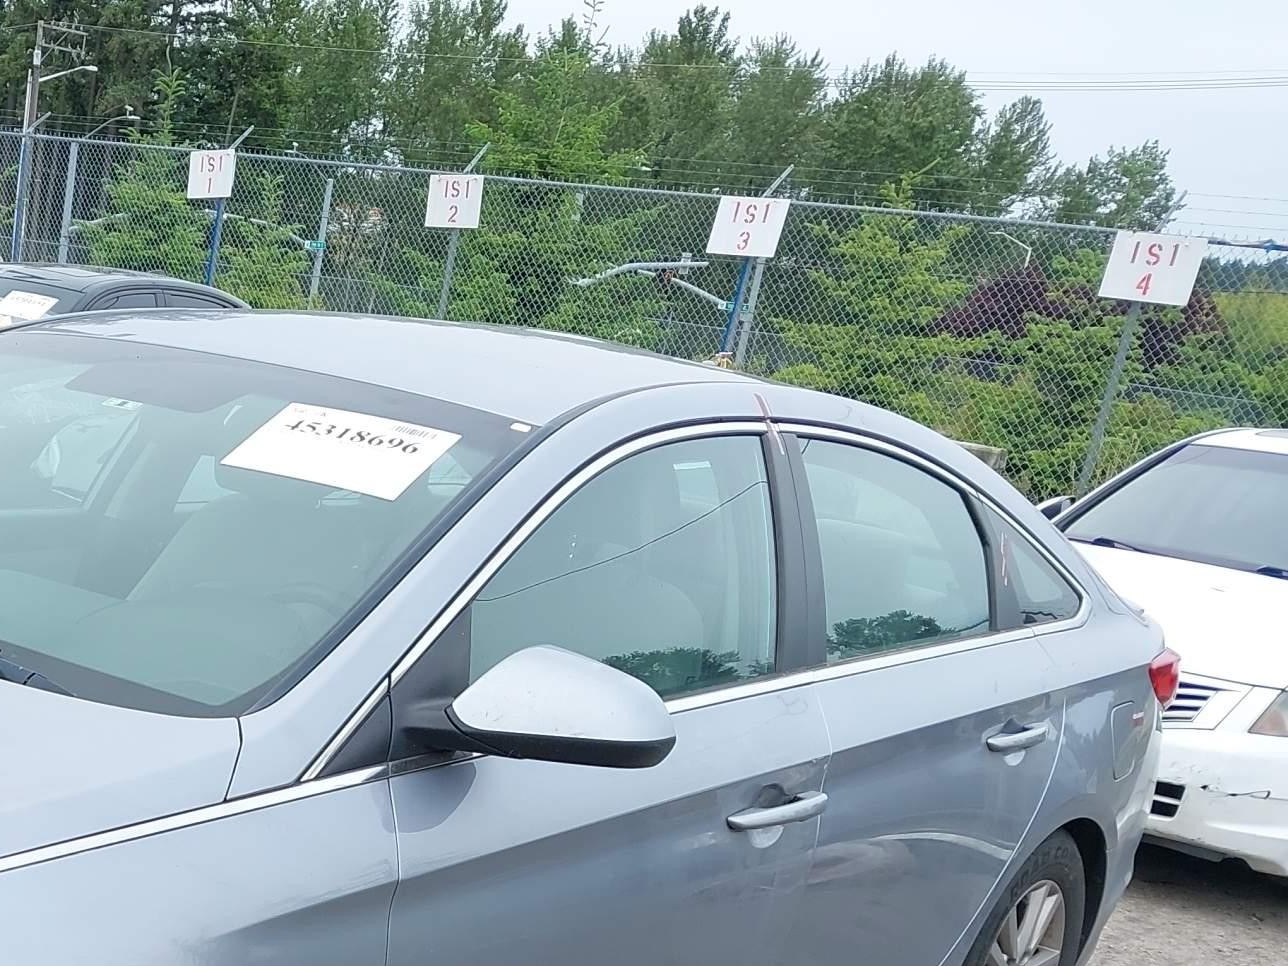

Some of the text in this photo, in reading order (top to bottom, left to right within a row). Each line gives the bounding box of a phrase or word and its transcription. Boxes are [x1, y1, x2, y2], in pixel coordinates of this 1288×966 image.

[447, 205, 458, 223] 2
[737, 231, 750, 250] 3
[1136, 273, 1152, 296] 4
[285, 419, 421, 454] 45318696
